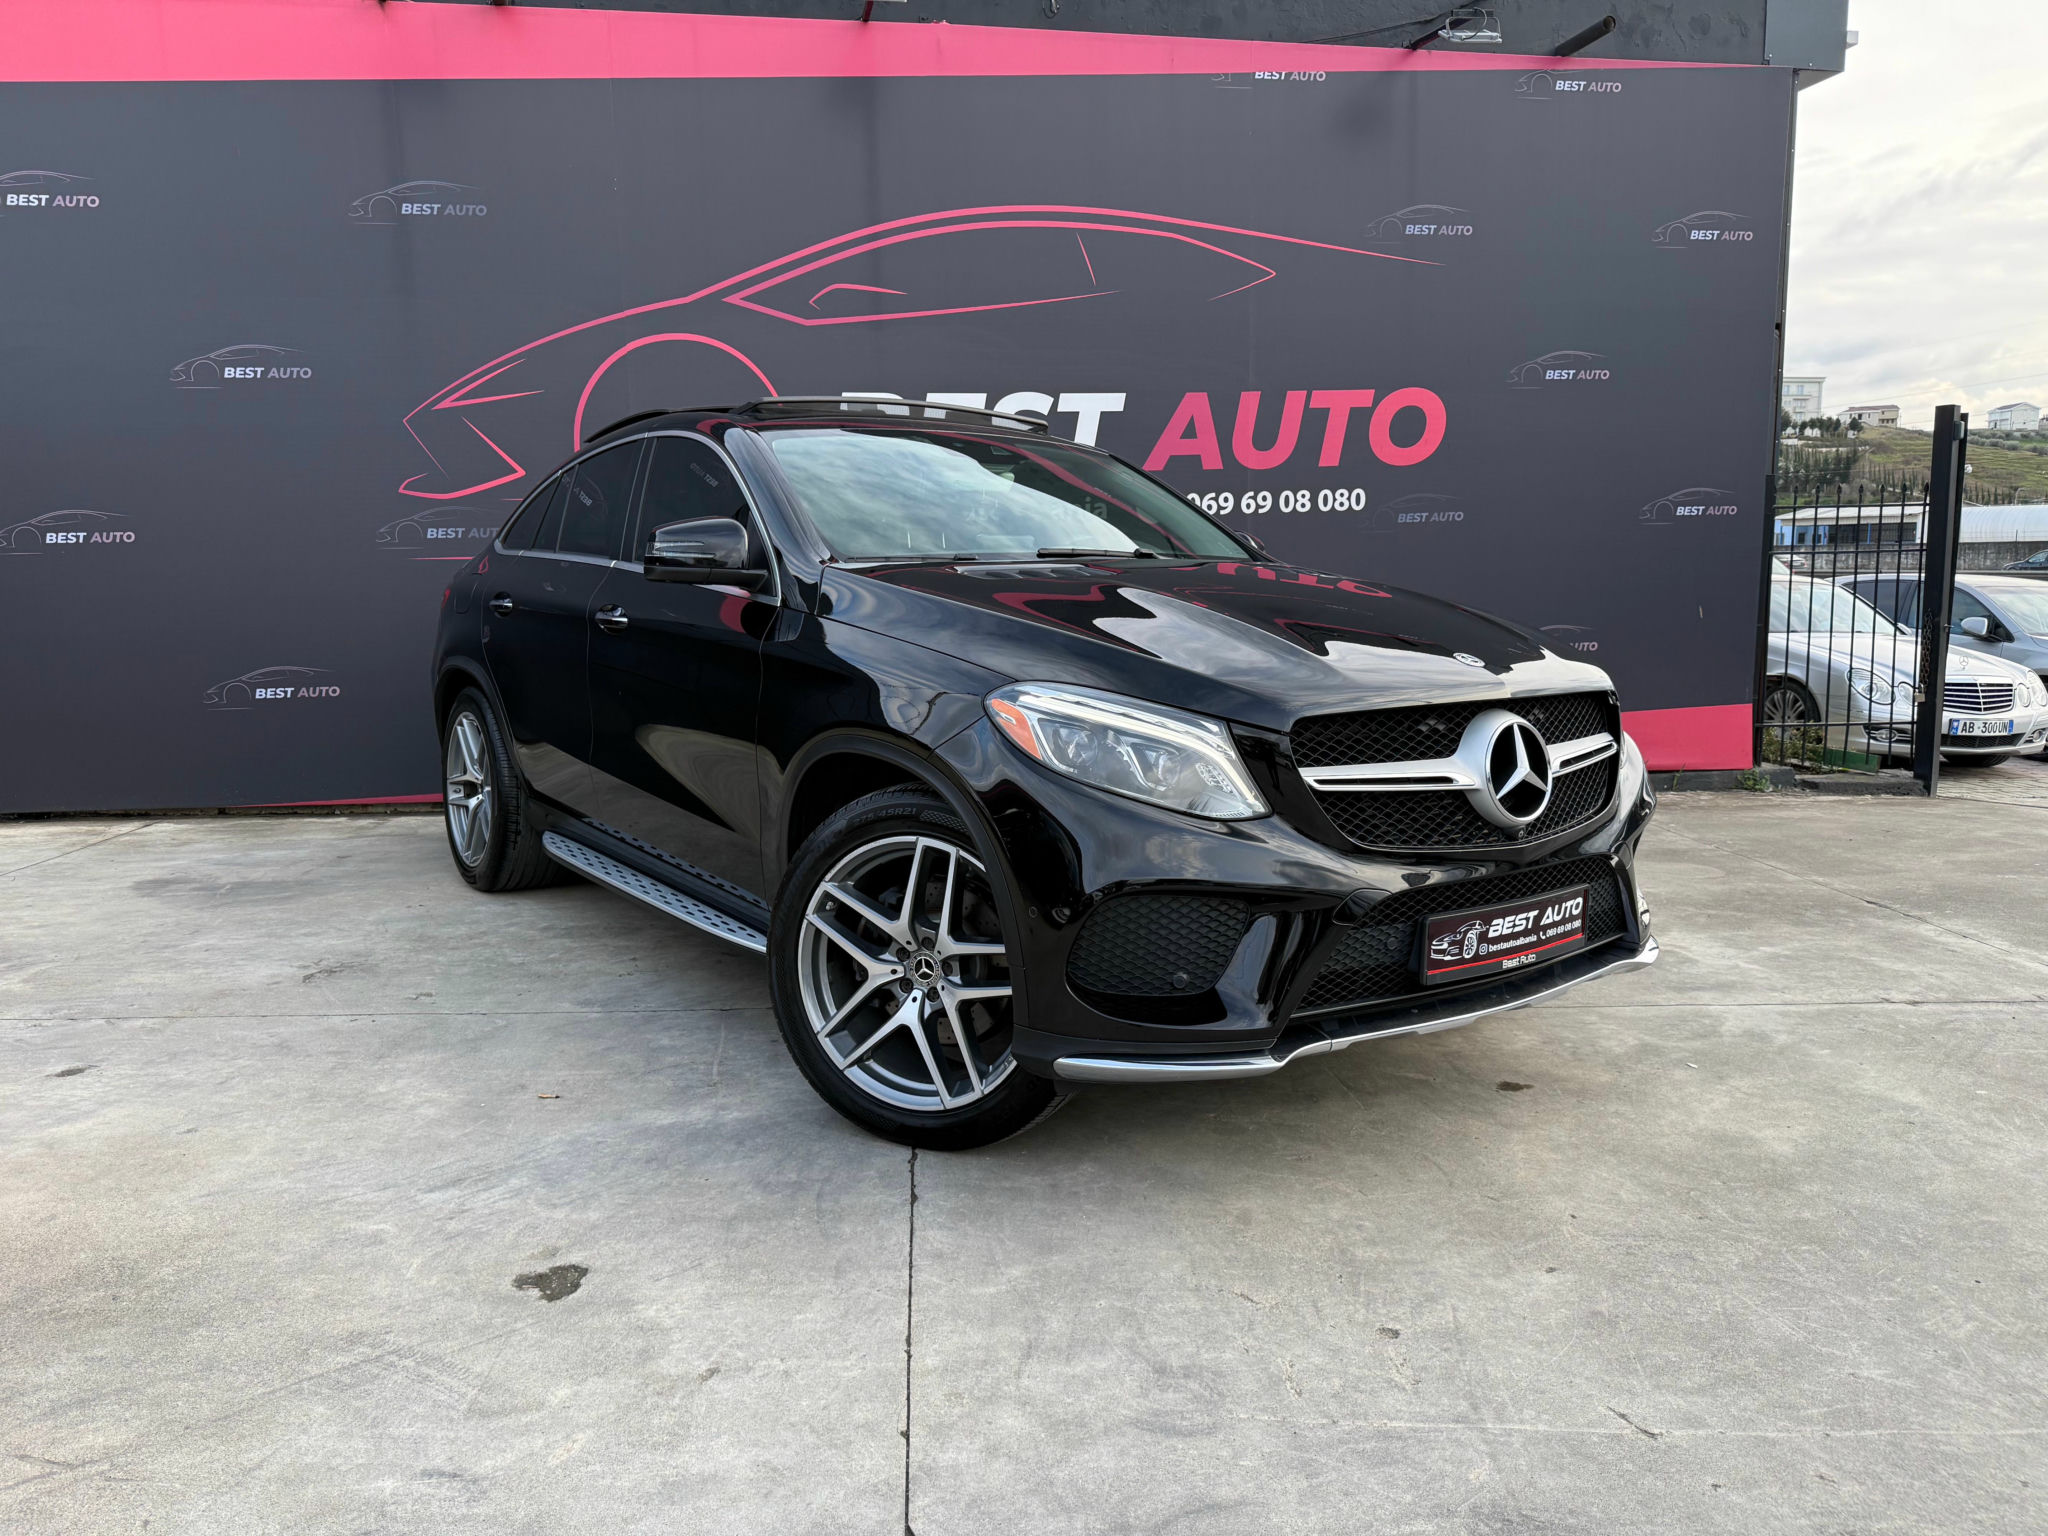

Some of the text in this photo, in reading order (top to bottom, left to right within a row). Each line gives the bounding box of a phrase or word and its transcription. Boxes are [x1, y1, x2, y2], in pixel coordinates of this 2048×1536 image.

[1255, 71, 1327, 82] BEST AUTO
[1555, 81, 1622, 93] BEST AUTO
[6, 194, 100, 208] BEST AUTO
[401, 202, 488, 216] BEST AUTO
[1405, 224, 1473, 236] BEST AUTO
[1690, 230, 1754, 241] BEST AUTO
[223, 366, 312, 379] BEST AUTO
[1545, 369, 1610, 380] BEST AUTO
[1142, 387, 1447, 471] AUTO
[1241, 490, 1273, 515] 69
[1279, 489, 1312, 513] 08
[1317, 488, 1367, 512] 080
[1676, 505, 1738, 516] BEST AUTO
[1397, 511, 1464, 524] BEST AUTO
[46, 532, 136, 544] BEST AUTO
[426, 528, 501, 539] BEST AUT
[1570, 642, 1598, 652] UTO
[255, 686, 341, 699] BEST AUTO
[1961, 721, 1975, 734] AB
[1488, 897, 1584, 938] BEST AUTO
[1488, 934, 1538, 952] bestautoalbania
[1502, 957, 1520, 969] Best
